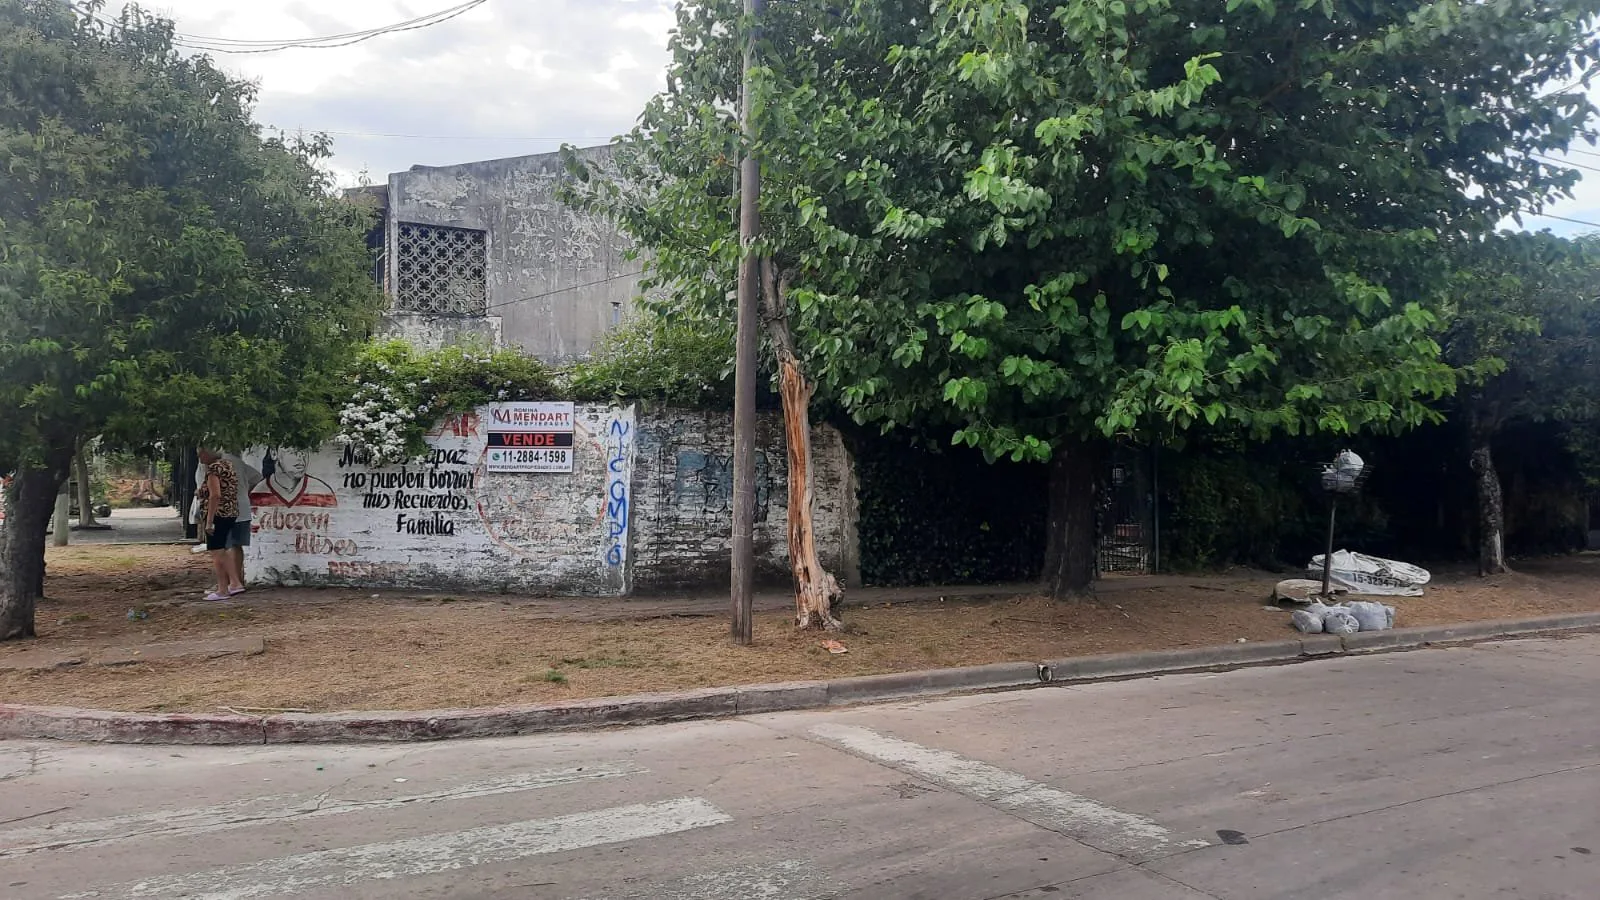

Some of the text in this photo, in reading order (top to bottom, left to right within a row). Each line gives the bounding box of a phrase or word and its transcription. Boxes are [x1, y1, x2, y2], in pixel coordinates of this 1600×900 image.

[513, 412, 570, 422] MENDART
[502, 433, 555, 446] VENDE
[502, 450, 566, 463] 11-2884-1598
[342, 466, 474, 492] no pueden borrar
[363, 491, 390, 509] mis
[396, 511, 455, 535] Familia
